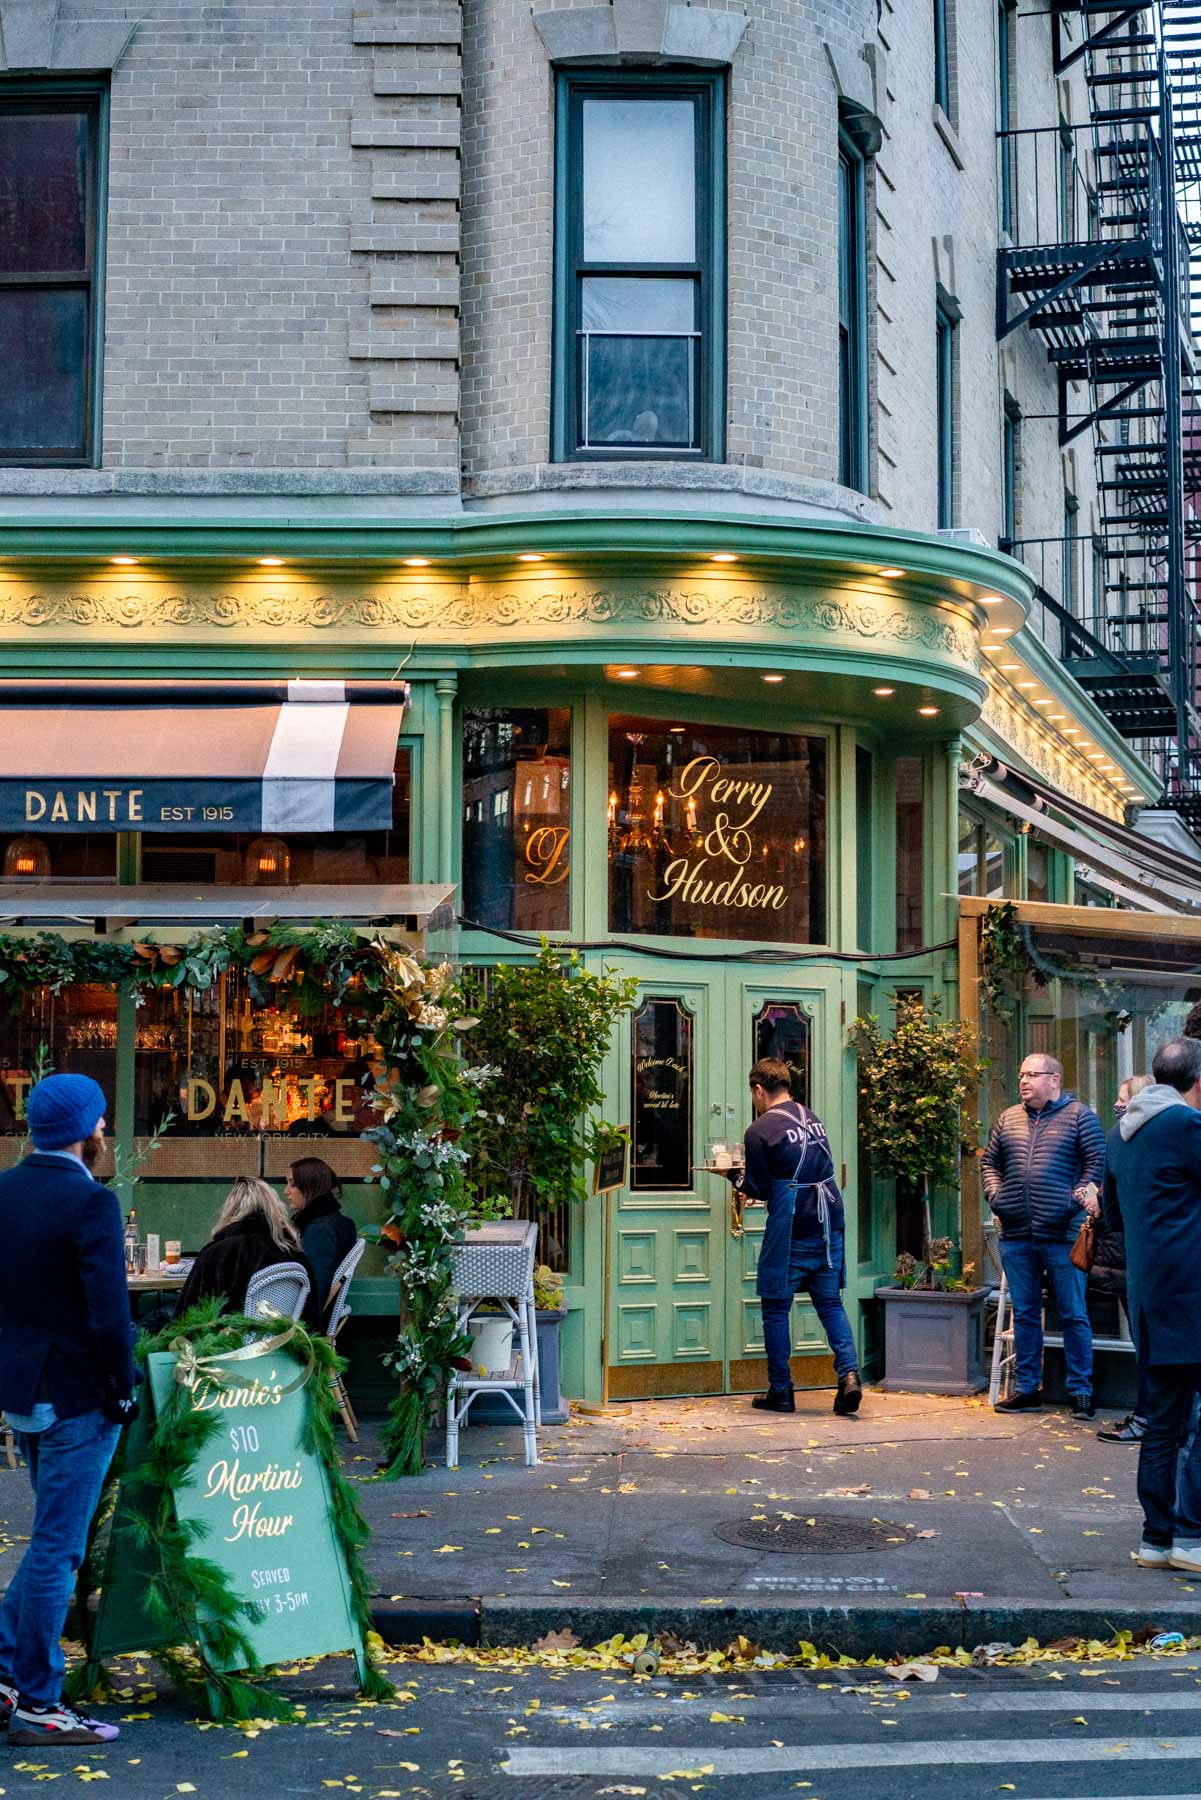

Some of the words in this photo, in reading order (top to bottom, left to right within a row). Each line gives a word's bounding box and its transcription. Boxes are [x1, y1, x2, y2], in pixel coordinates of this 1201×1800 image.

[25, 790, 144, 822] DANTE
[161, 808, 195, 821] EST
[203, 807, 234, 820] 1915
[668, 756, 772, 830] Perry
[705, 812, 752, 865] &
[647, 858, 788, 909] Hudson
[276, 1058, 304, 1070] 1915
[187, 1077, 356, 1122] DANTE
[192, 1370, 283, 1411] Dante's
[230, 1426, 259, 1453] $10
[204, 1459, 302, 1501] Martini
[224, 1502, 293, 1542] Hour
